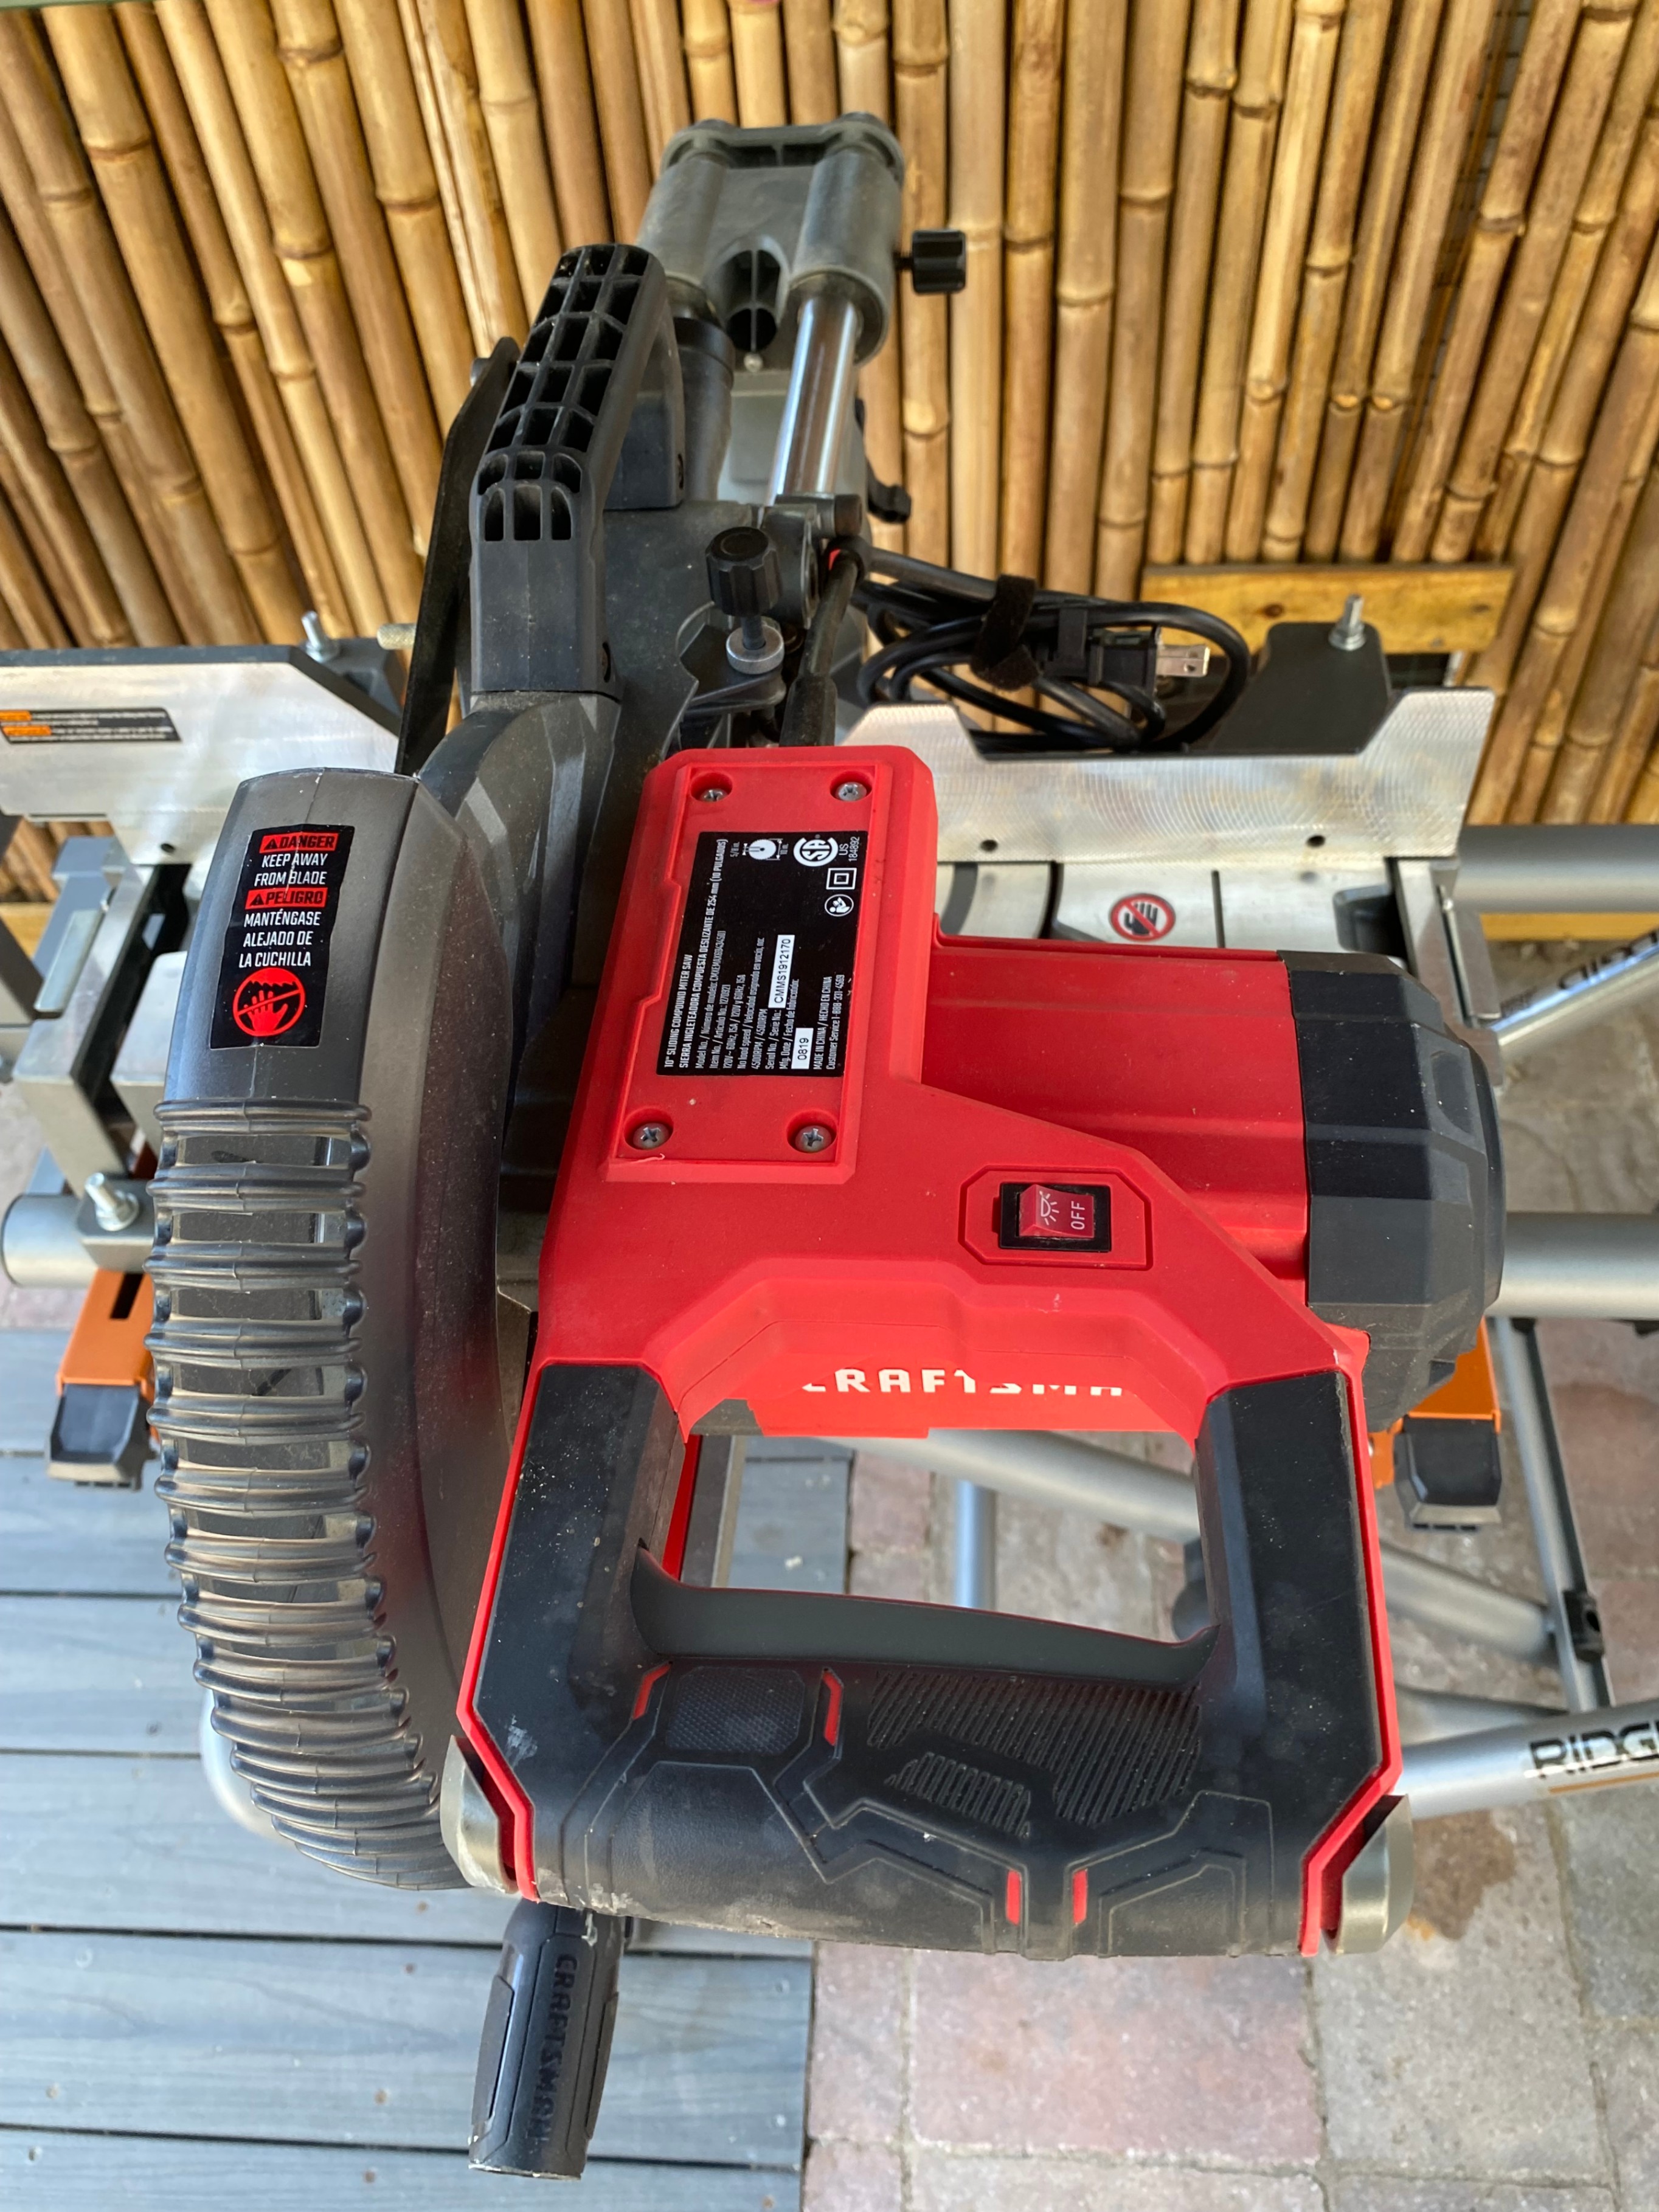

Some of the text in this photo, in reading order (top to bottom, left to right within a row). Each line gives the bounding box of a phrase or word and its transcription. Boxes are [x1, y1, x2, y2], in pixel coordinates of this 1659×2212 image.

[278, 835, 334, 849] DANGER
[839, 843, 848, 855] US
[848, 837, 859, 862] 184892
[261, 853, 328, 868] KEEP AWAY
[713, 839, 728, 871] PULGADOS)
[254, 871, 327, 887] FROM BLADE
[710, 872, 722, 881] (10
[265, 890, 324, 905] PELIGRO
[707, 894, 717, 906] 254
[244, 908, 322, 927] MANTÉNGASE
[243, 930, 314, 947] ALEJADO DE
[699, 916, 713, 952] DESLIZANTE
[238, 951, 311, 968] LA CUCHILLA
[692, 953, 707, 991] COMPUESTA
[736, 974, 746, 983] 15A
[774, 939, 791, 1003] CMMS1912170
[822, 976, 832, 993] CHINA
[664, 954, 693, 1067] 10" SLIDING COMPOUND MITER SAW
[684, 992, 700, 1041] INGLETEADORA
[730, 1004, 741, 1017] 120V
[819, 1002, 829, 1021] HECHO
[701, 1012, 712, 1034] Número
[713, 1017, 726, 1038] Artículo
[729, 1023, 738, 1032] 15A
[756, 1009, 767, 1035] 4500RPM
[769, 1021, 780, 1035] Serie
[783, 1019, 794, 1035] Fecha
[829, 1020, 840, 1040] Service
[742, 1029, 751, 1046] speed
[816, 1027, 826, 1044] CHINA
[698, 1040, 708, 1049] No.
[711, 1045, 721, 1054] No.
[738, 1047, 749, 1059] load
[767, 1042, 777, 1051] No.
[780, 1042, 791, 1056] Date
[797, 1038, 809, 1059] 0819
[679, 1042, 691, 1068] SIERRA
[695, 1050, 706, 1068] Model
[709, 1055, 719, 1068] Item
[751, 1042, 763, 1069] 4500RPM
[765, 1052, 775, 1069] Serial
[779, 1056, 791, 1069] Mfg.
[813, 1053, 823, 1069] MADE
[826, 1042, 837, 1069] Customer
[1070, 1200, 1086, 1230] OFF
[530, 1955, 577, 2141] CRAFTSMAN
